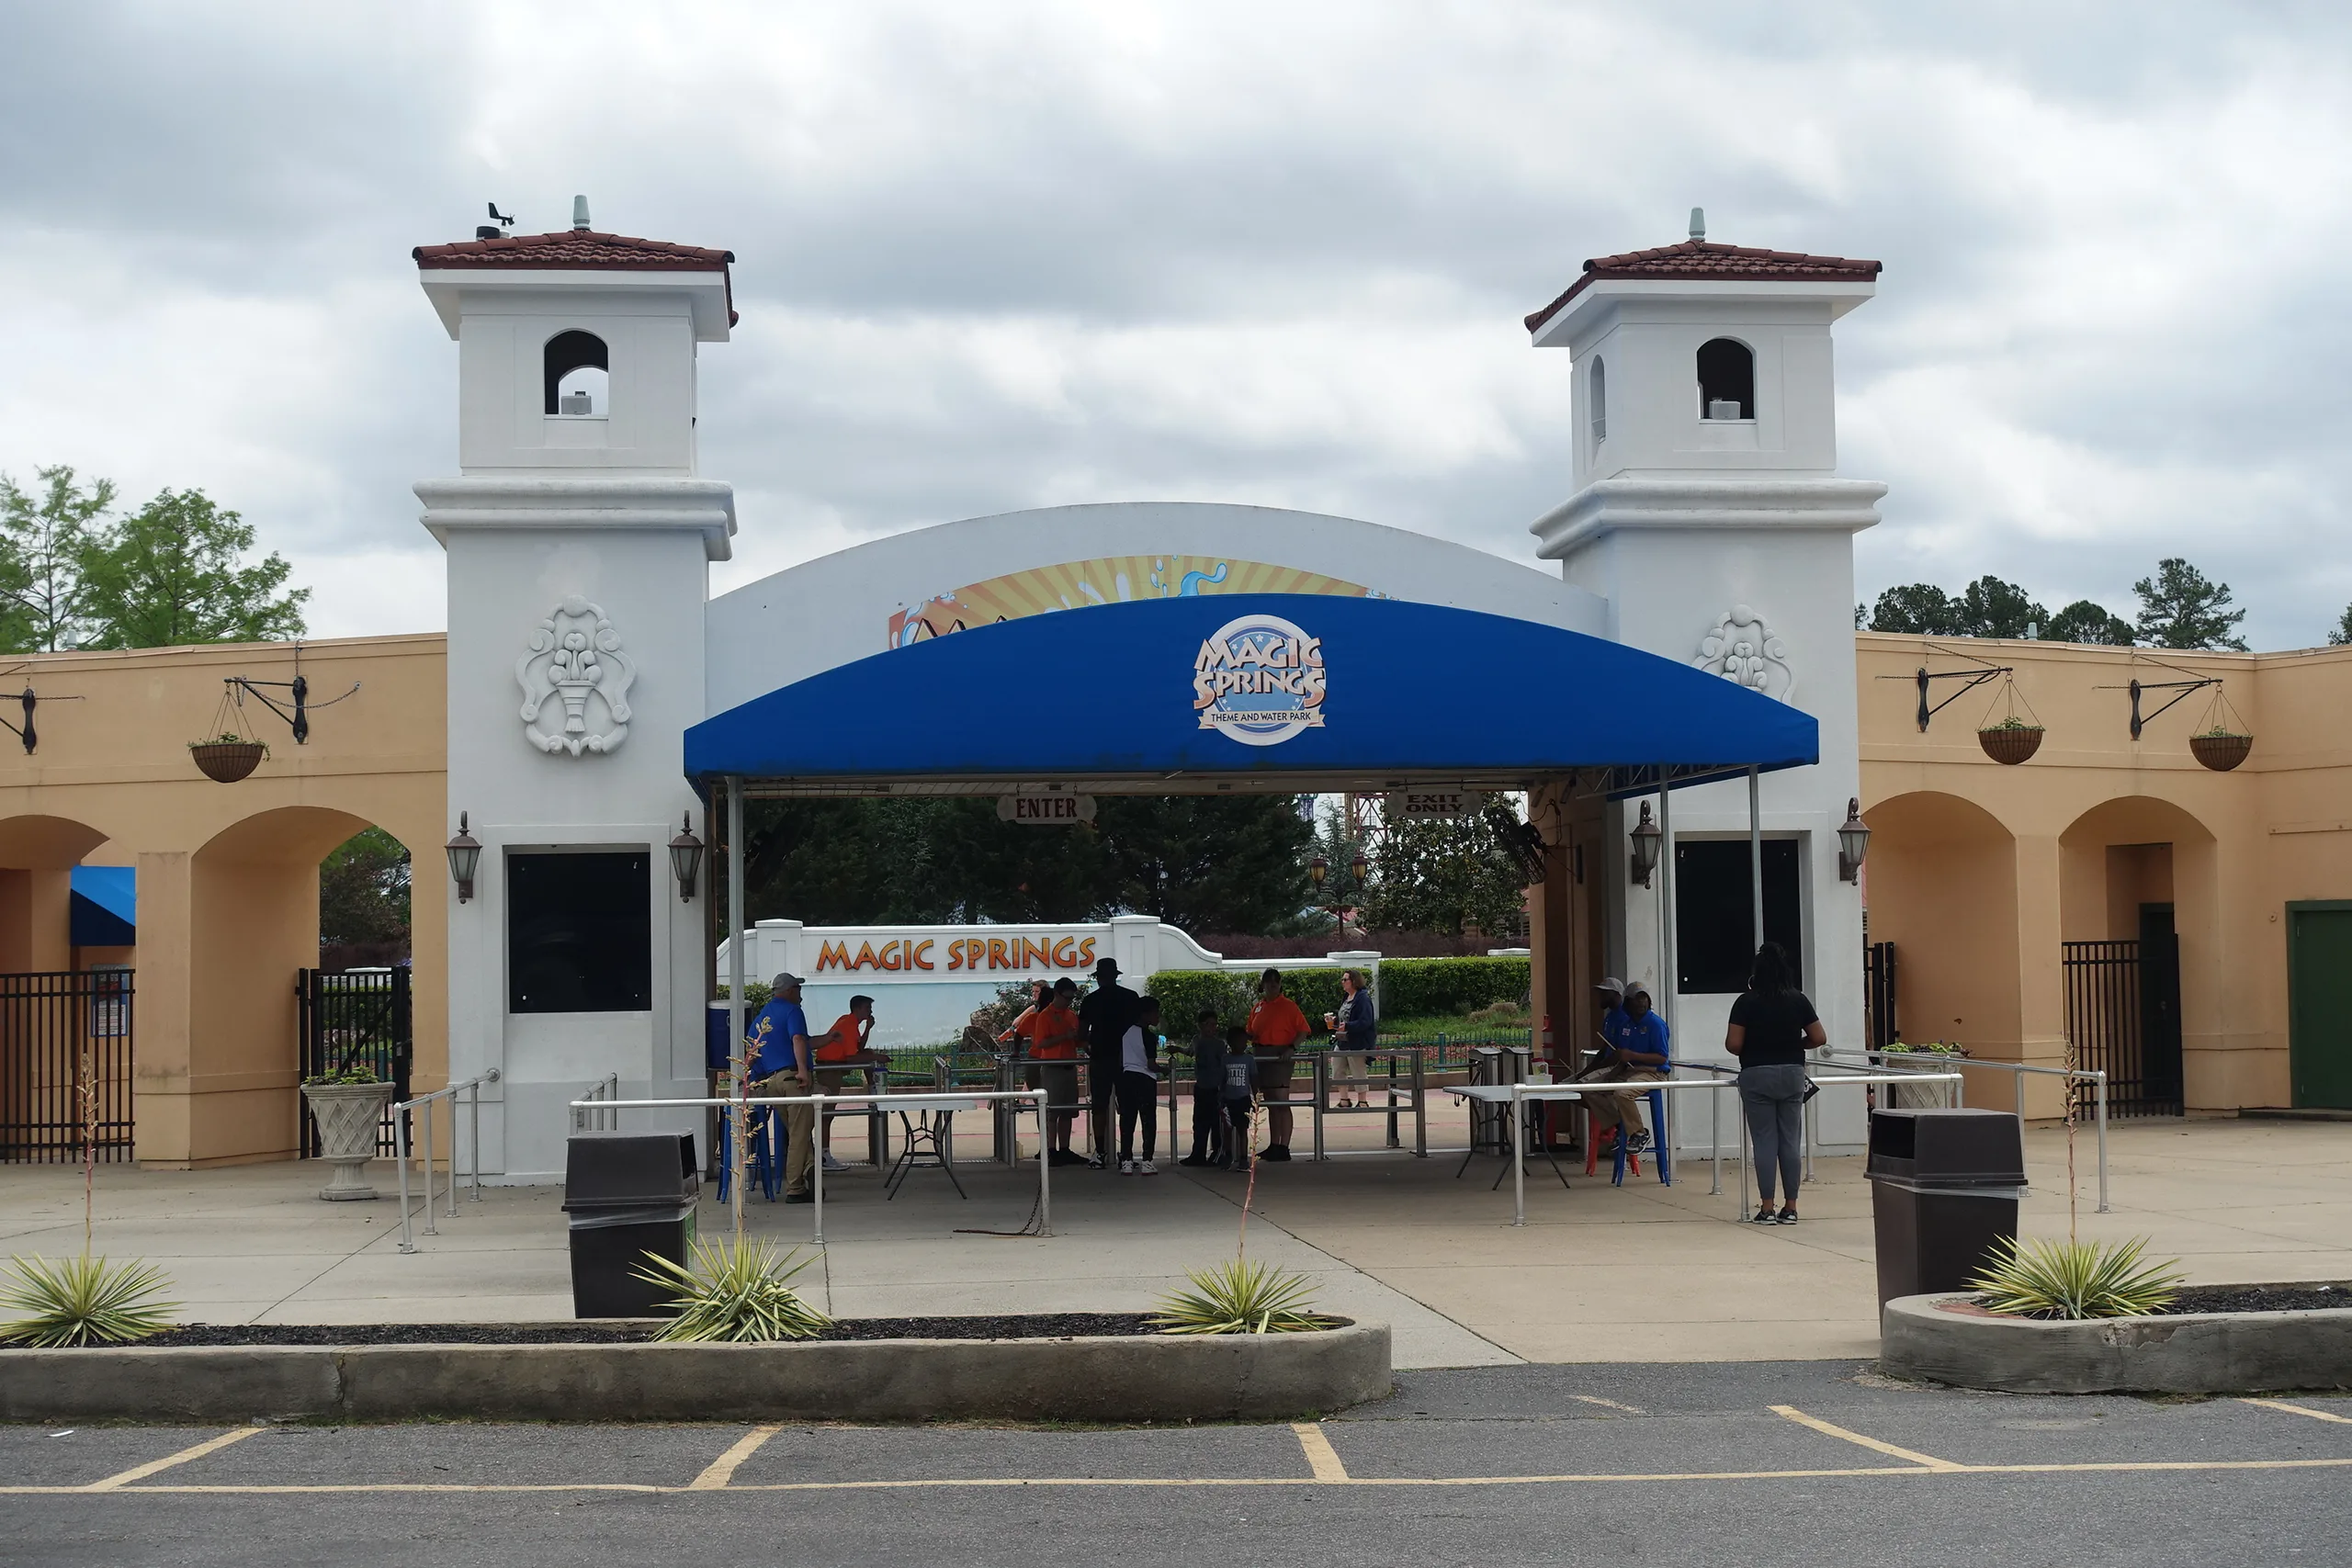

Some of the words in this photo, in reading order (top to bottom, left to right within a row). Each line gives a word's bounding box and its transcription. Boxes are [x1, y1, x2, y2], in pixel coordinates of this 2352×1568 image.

[1193, 637, 1324, 671] MAGIC
[1193, 670, 1326, 709] SPRINGS
[1211, 713, 1238, 722] THEME
[1240, 713, 1260, 721] AND
[1261, 712, 1286, 721] WATER
[1290, 712, 1311, 720] PARK
[1015, 797, 1078, 818] ENTER
[1406, 804, 1463, 812] ONLY
[1407, 795, 1462, 803] EXIT
[816, 939, 934, 971] MAGIC
[947, 936, 1095, 970] SPRINGS
